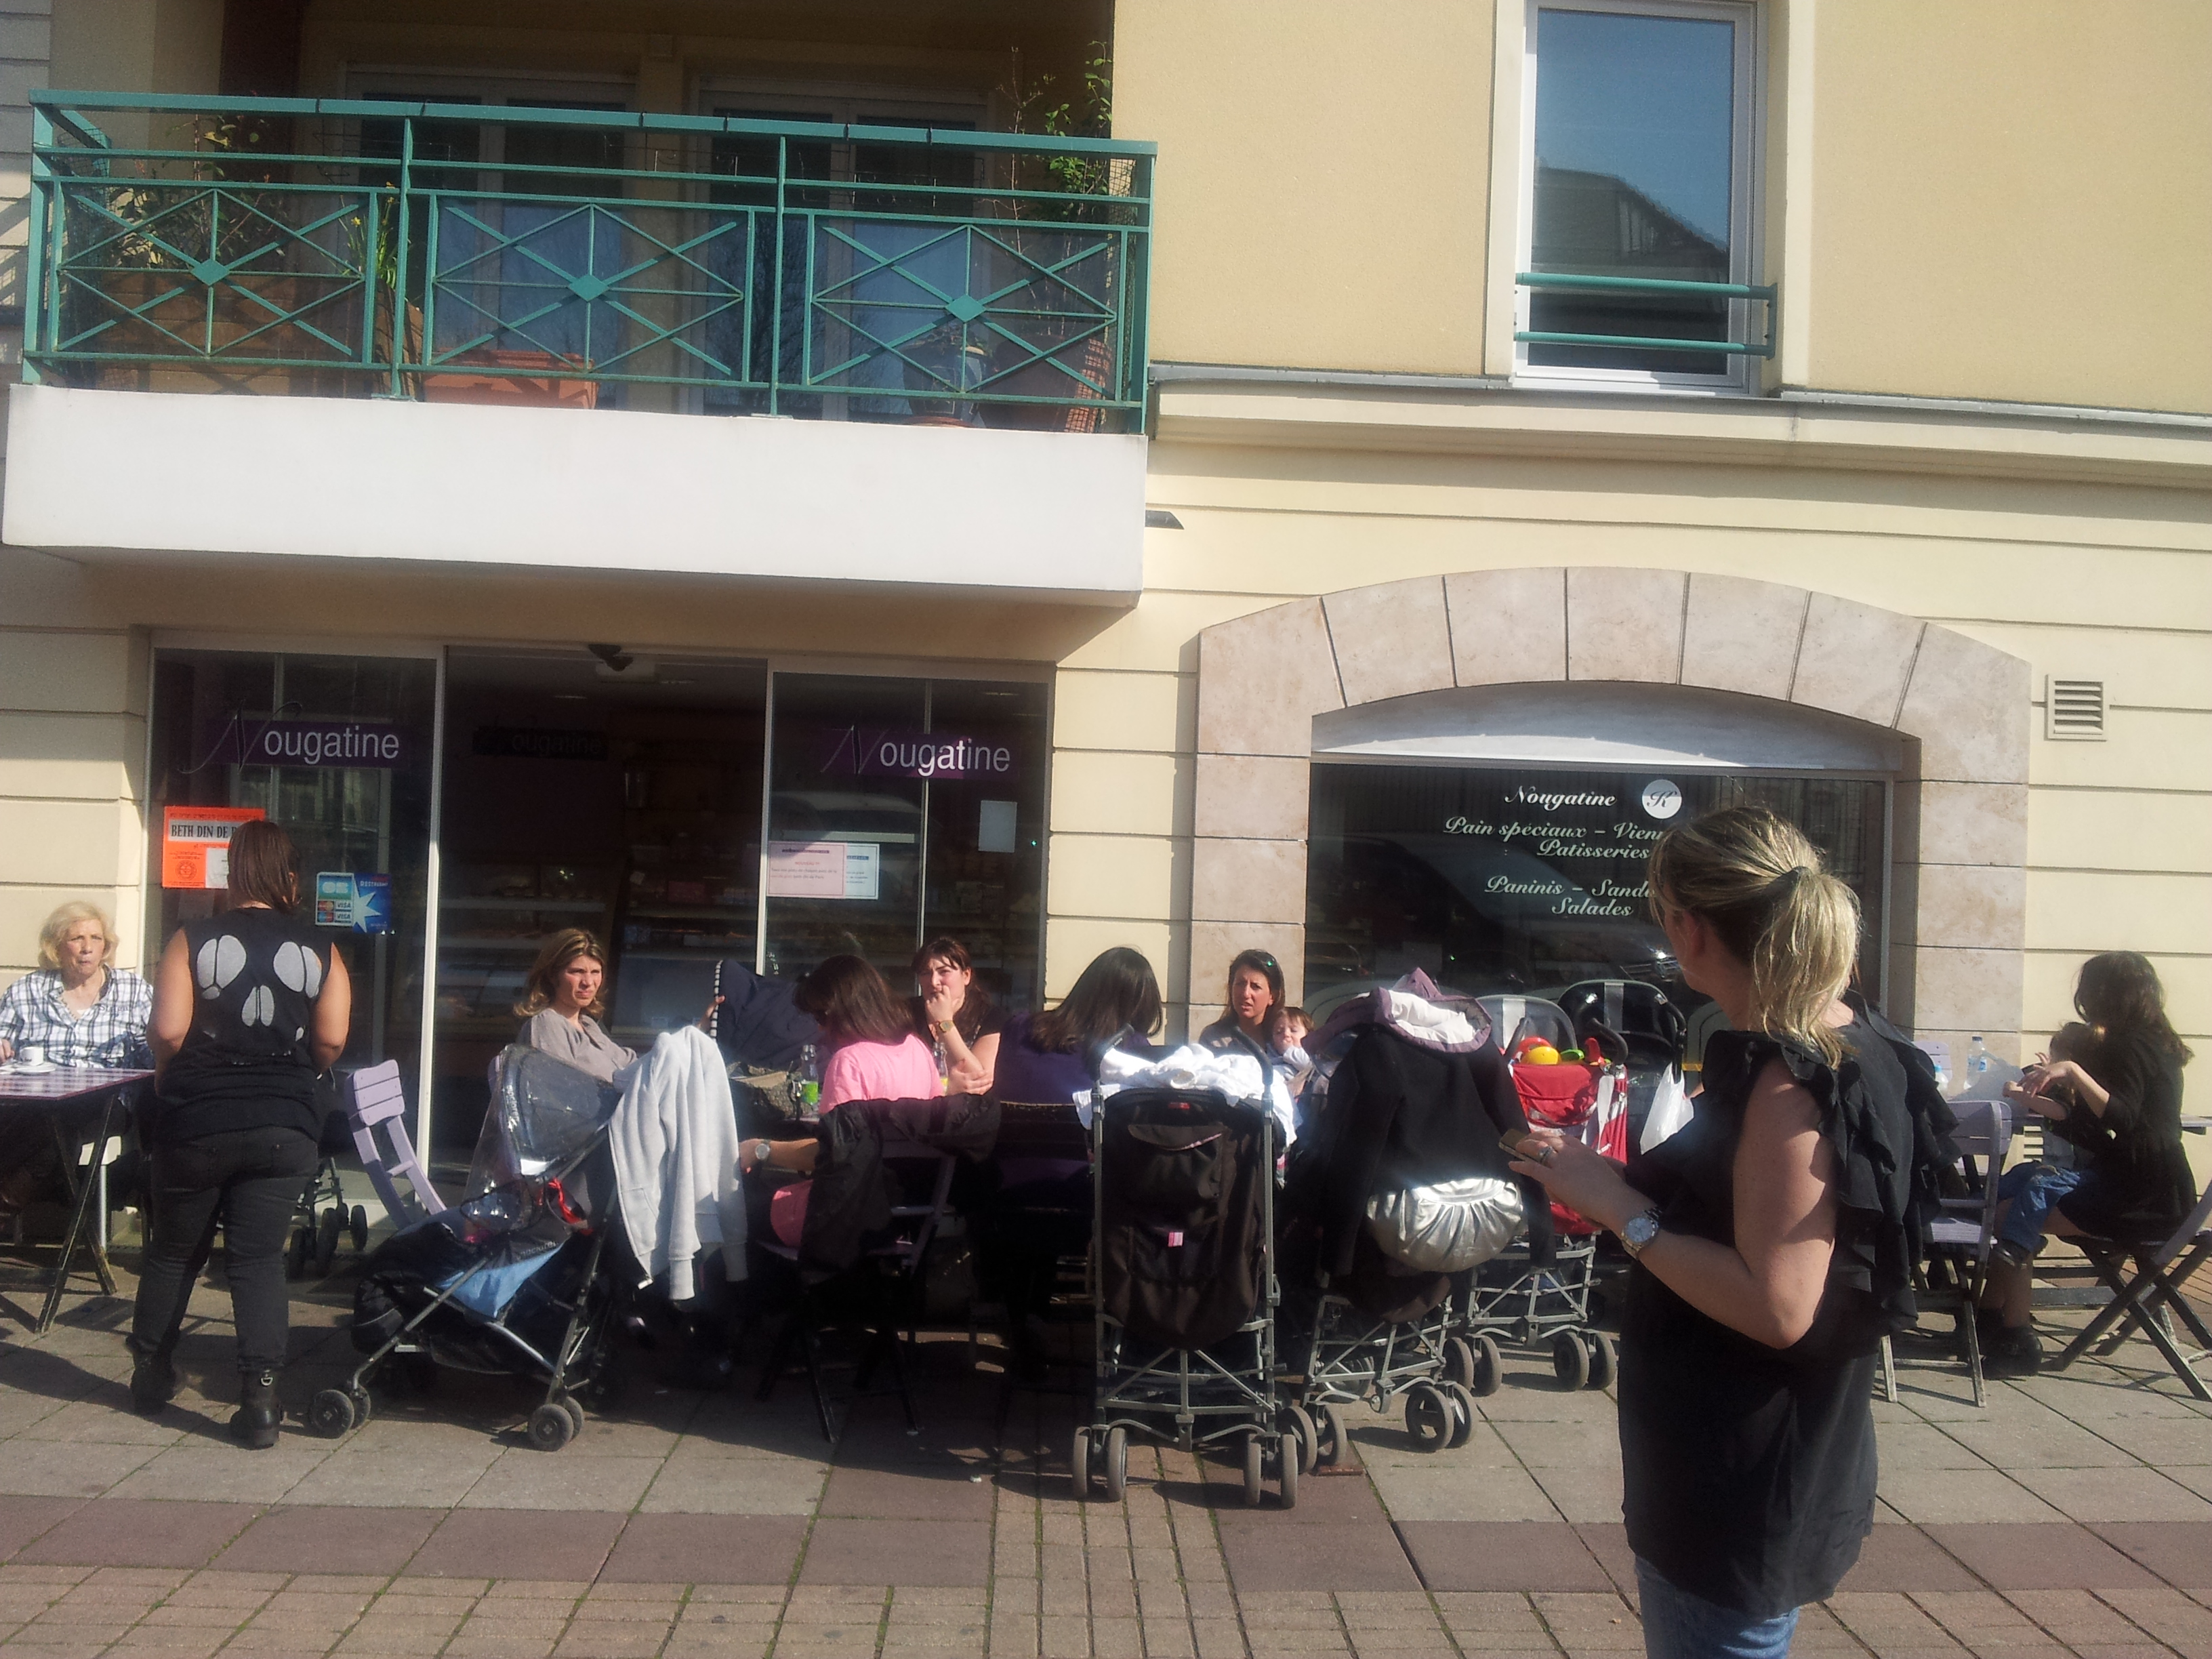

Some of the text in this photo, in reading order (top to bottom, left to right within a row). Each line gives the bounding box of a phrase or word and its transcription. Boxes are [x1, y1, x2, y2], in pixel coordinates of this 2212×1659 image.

[820, 724, 1010, 777] Nougatine
[1504, 785, 1616, 811] Nougatine
[171, 825, 194, 838] BETH
[197, 825, 213, 838] DIN
[217, 826, 228, 839] DE
[1443, 816, 1495, 835] Pain
[1498, 822, 1588, 842] spéciaux
[1537, 839, 1650, 859] Patisseries
[1484, 876, 1565, 895] Paninis
[1552, 897, 1634, 916] Salades
